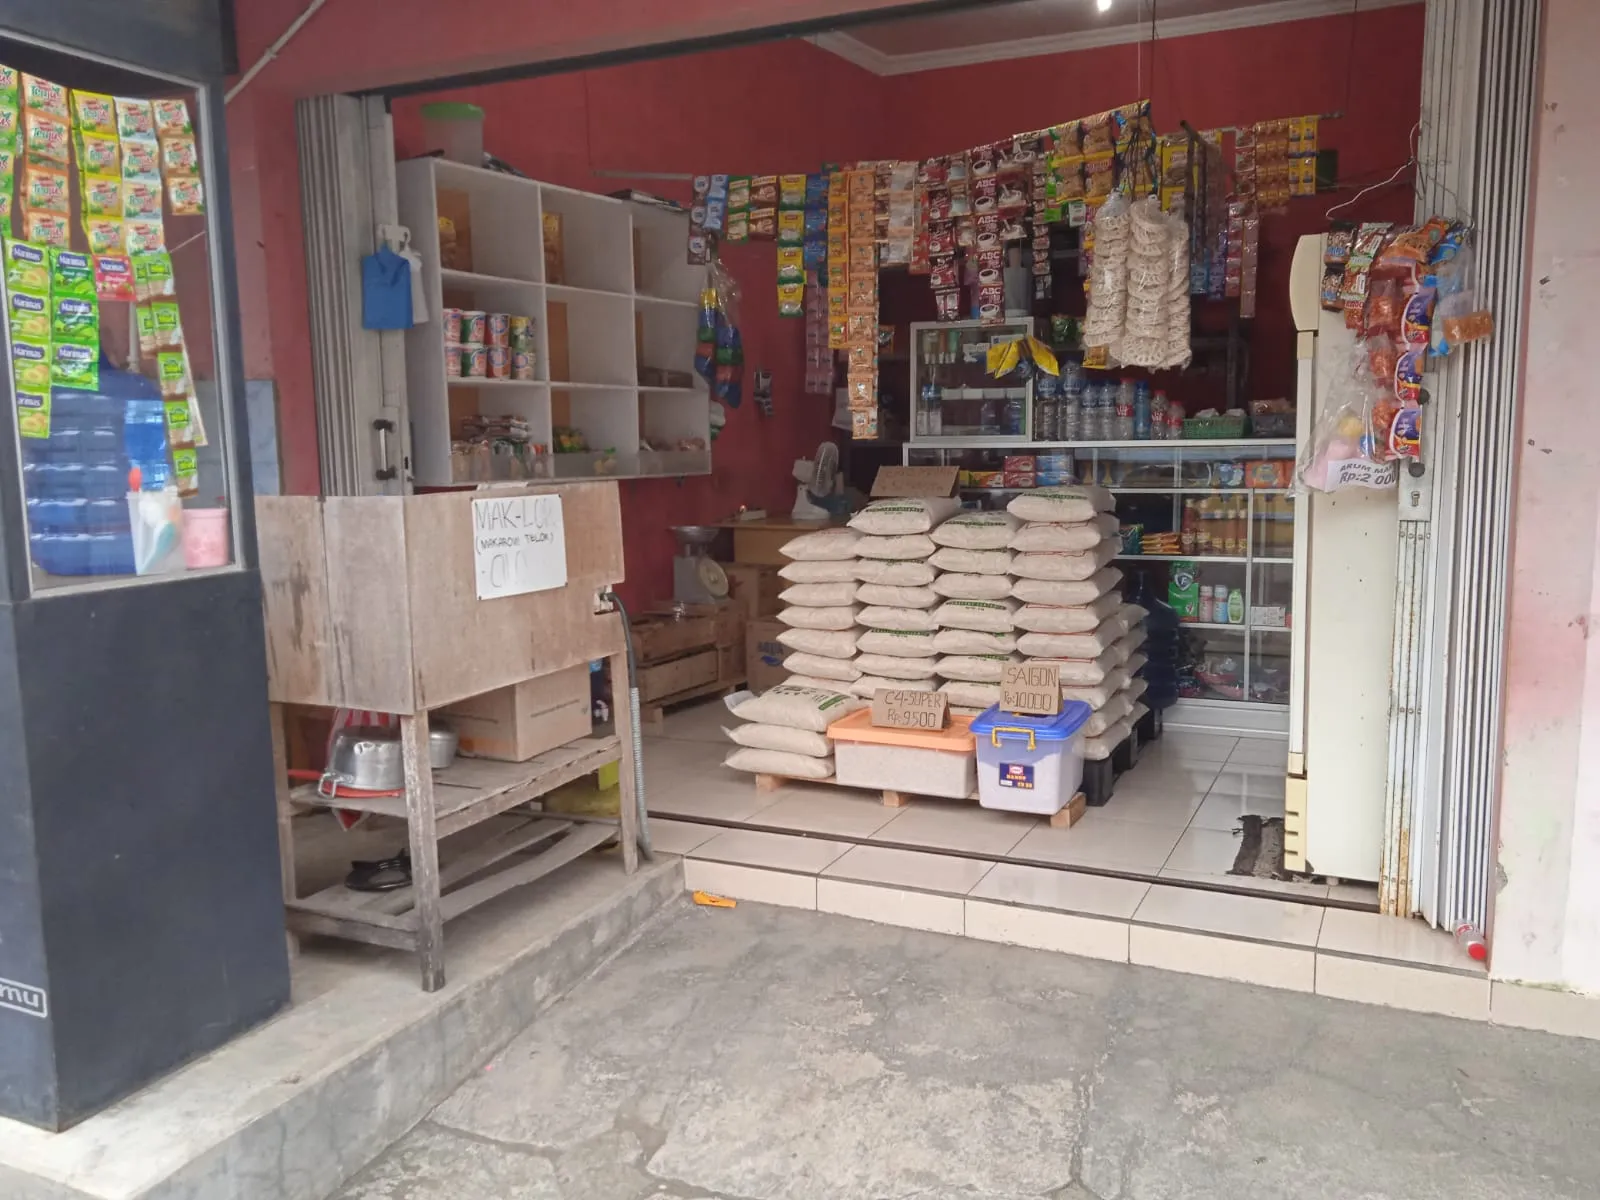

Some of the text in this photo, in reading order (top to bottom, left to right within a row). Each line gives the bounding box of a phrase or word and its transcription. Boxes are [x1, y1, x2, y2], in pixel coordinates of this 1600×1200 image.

[976, 178, 996, 189] ABC
[978, 215, 998, 225] ABC
[980, 251, 1000, 260] ABC
[981, 287, 1001, 296] ABC
[1006, 667, 1057, 688] SAIGON
